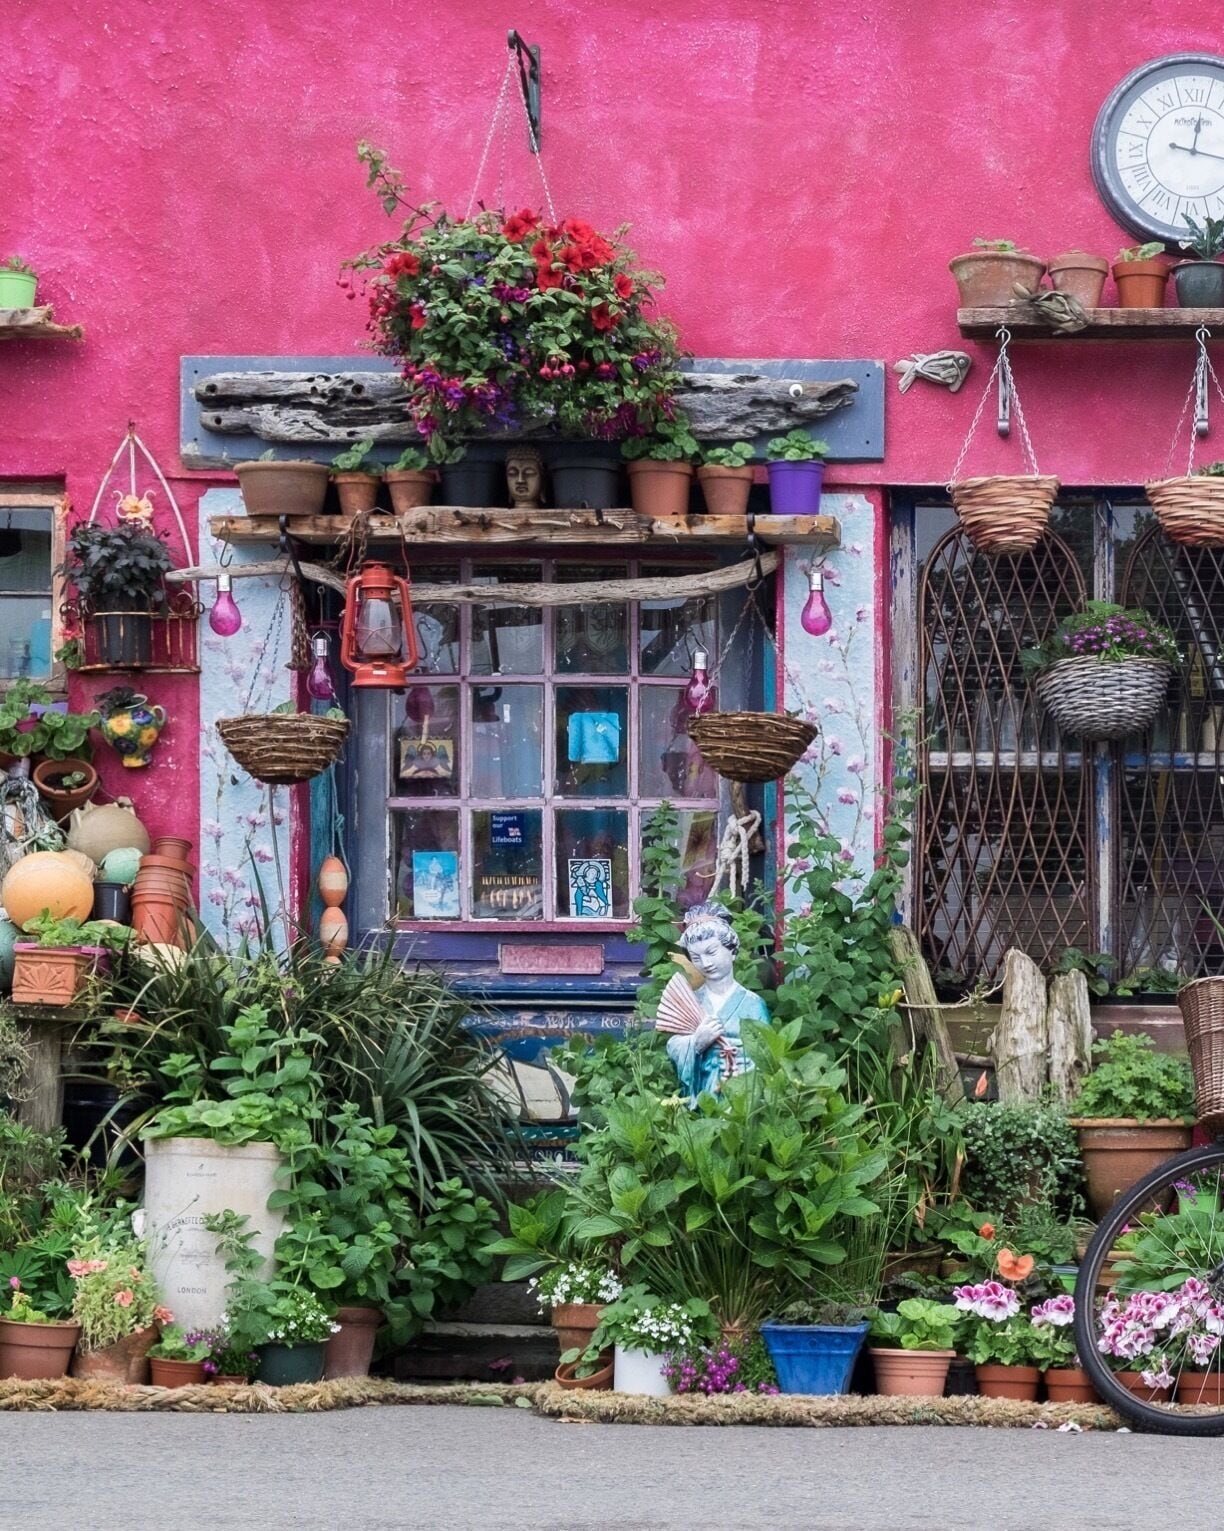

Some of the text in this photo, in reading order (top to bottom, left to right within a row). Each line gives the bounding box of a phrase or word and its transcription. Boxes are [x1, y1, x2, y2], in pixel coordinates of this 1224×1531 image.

[1157, 93, 1174, 111] XI
[1185, 88, 1204, 103] XII
[1137, 115, 1152, 129] X
[1129, 142, 1143, 158] IX
[1132, 166, 1151, 192] VIII
[1152, 190, 1170, 210] VII
[177, 1286, 207, 1295] LONDON
